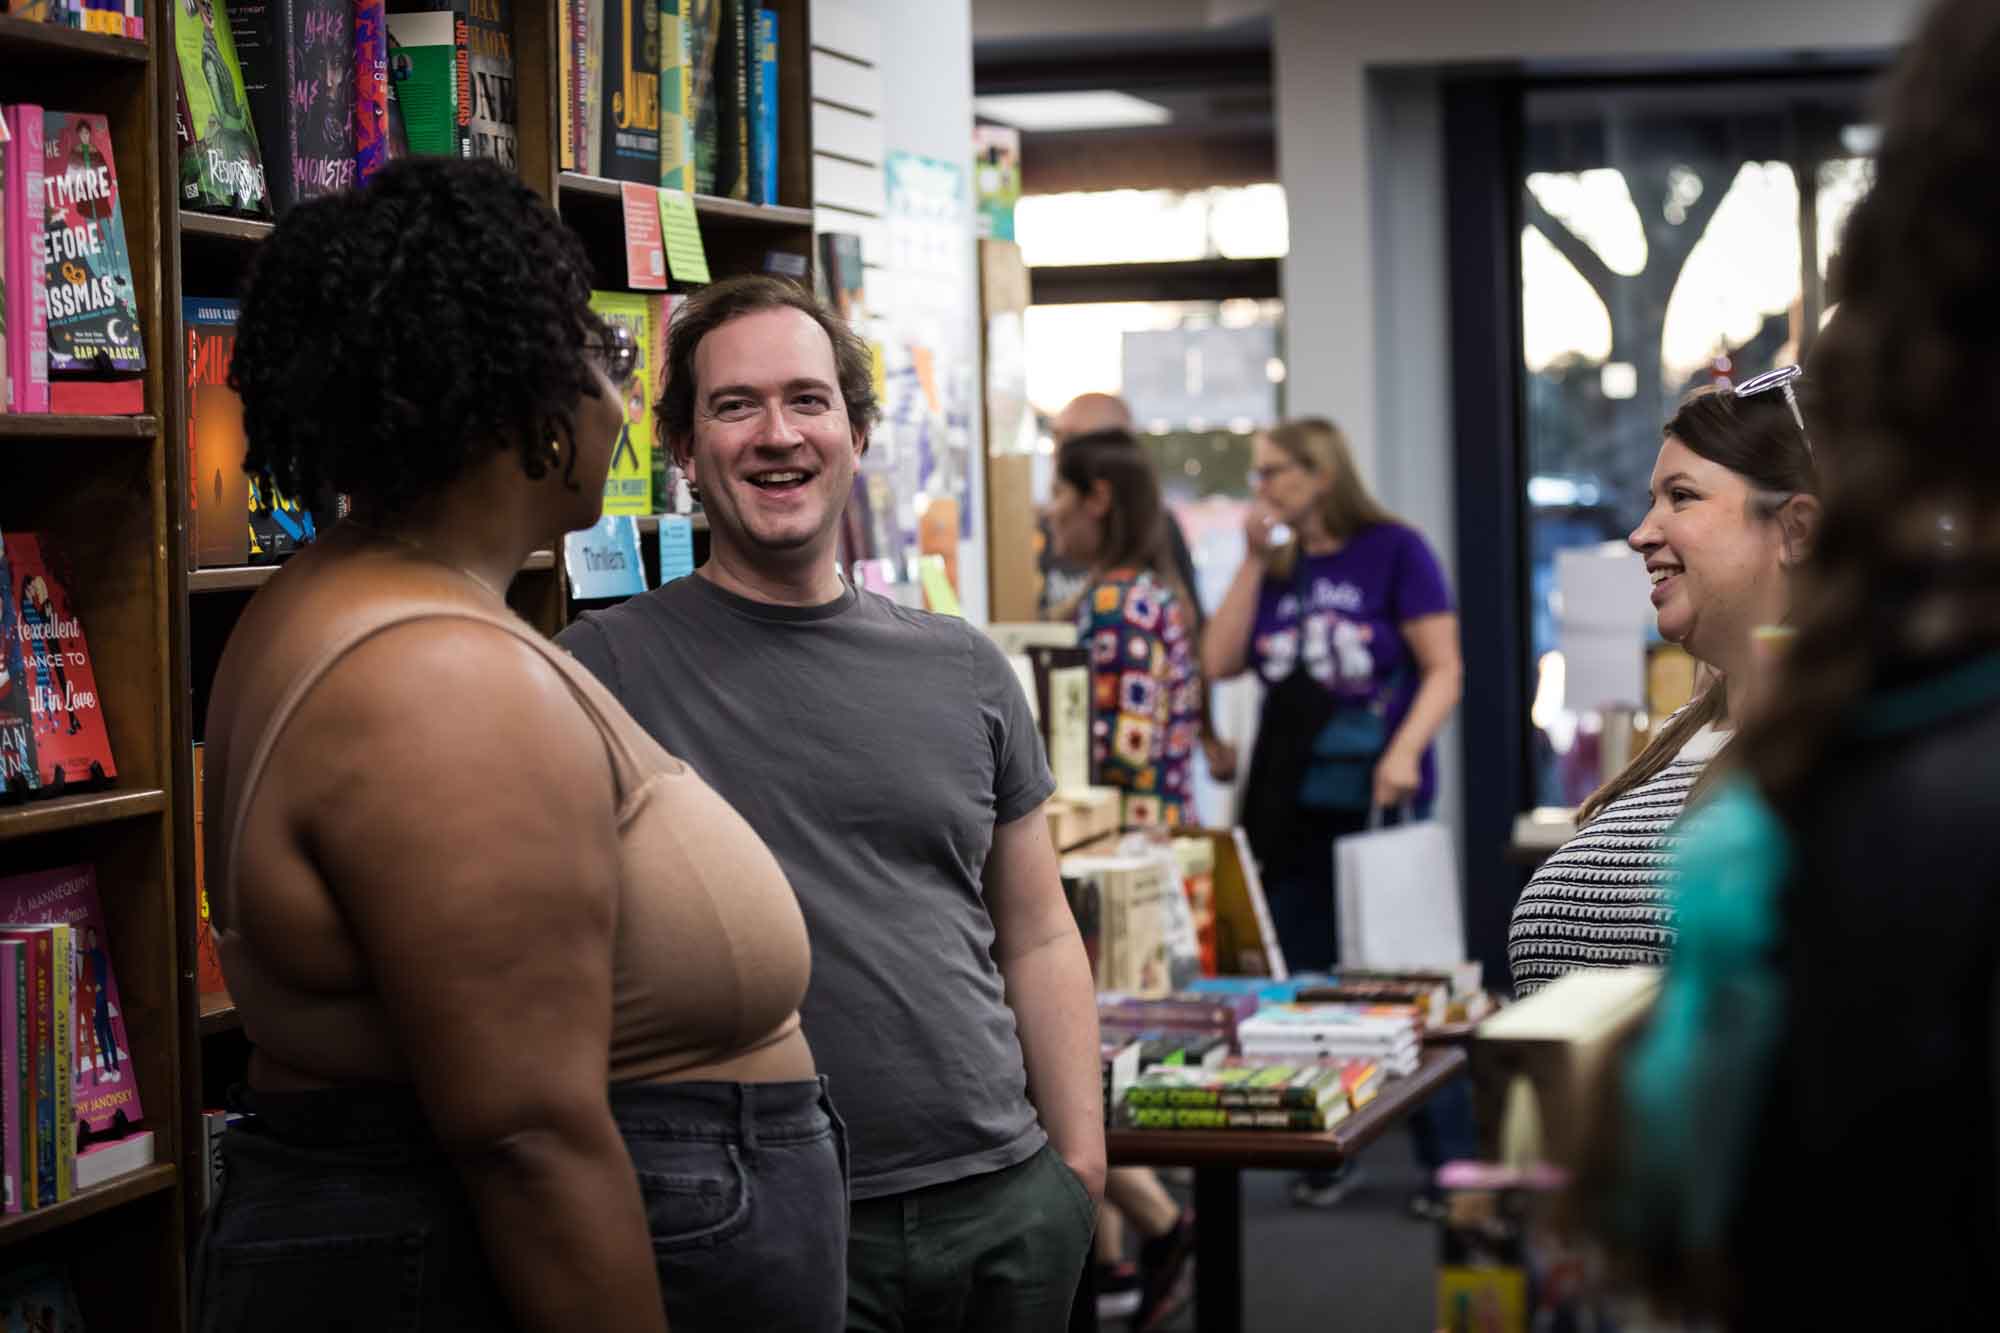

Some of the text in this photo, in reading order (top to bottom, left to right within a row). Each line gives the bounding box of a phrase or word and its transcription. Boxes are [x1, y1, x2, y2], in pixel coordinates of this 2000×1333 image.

[44, 139, 61, 160] HE
[44, 165, 111, 209] TMARE
[293, 155, 357, 191] MONSTER
[44, 222, 101, 264] EFORE
[45, 275, 116, 321] ISSMAS
[65, 651, 86, 666] TO
[64, 679, 96, 712] Love
